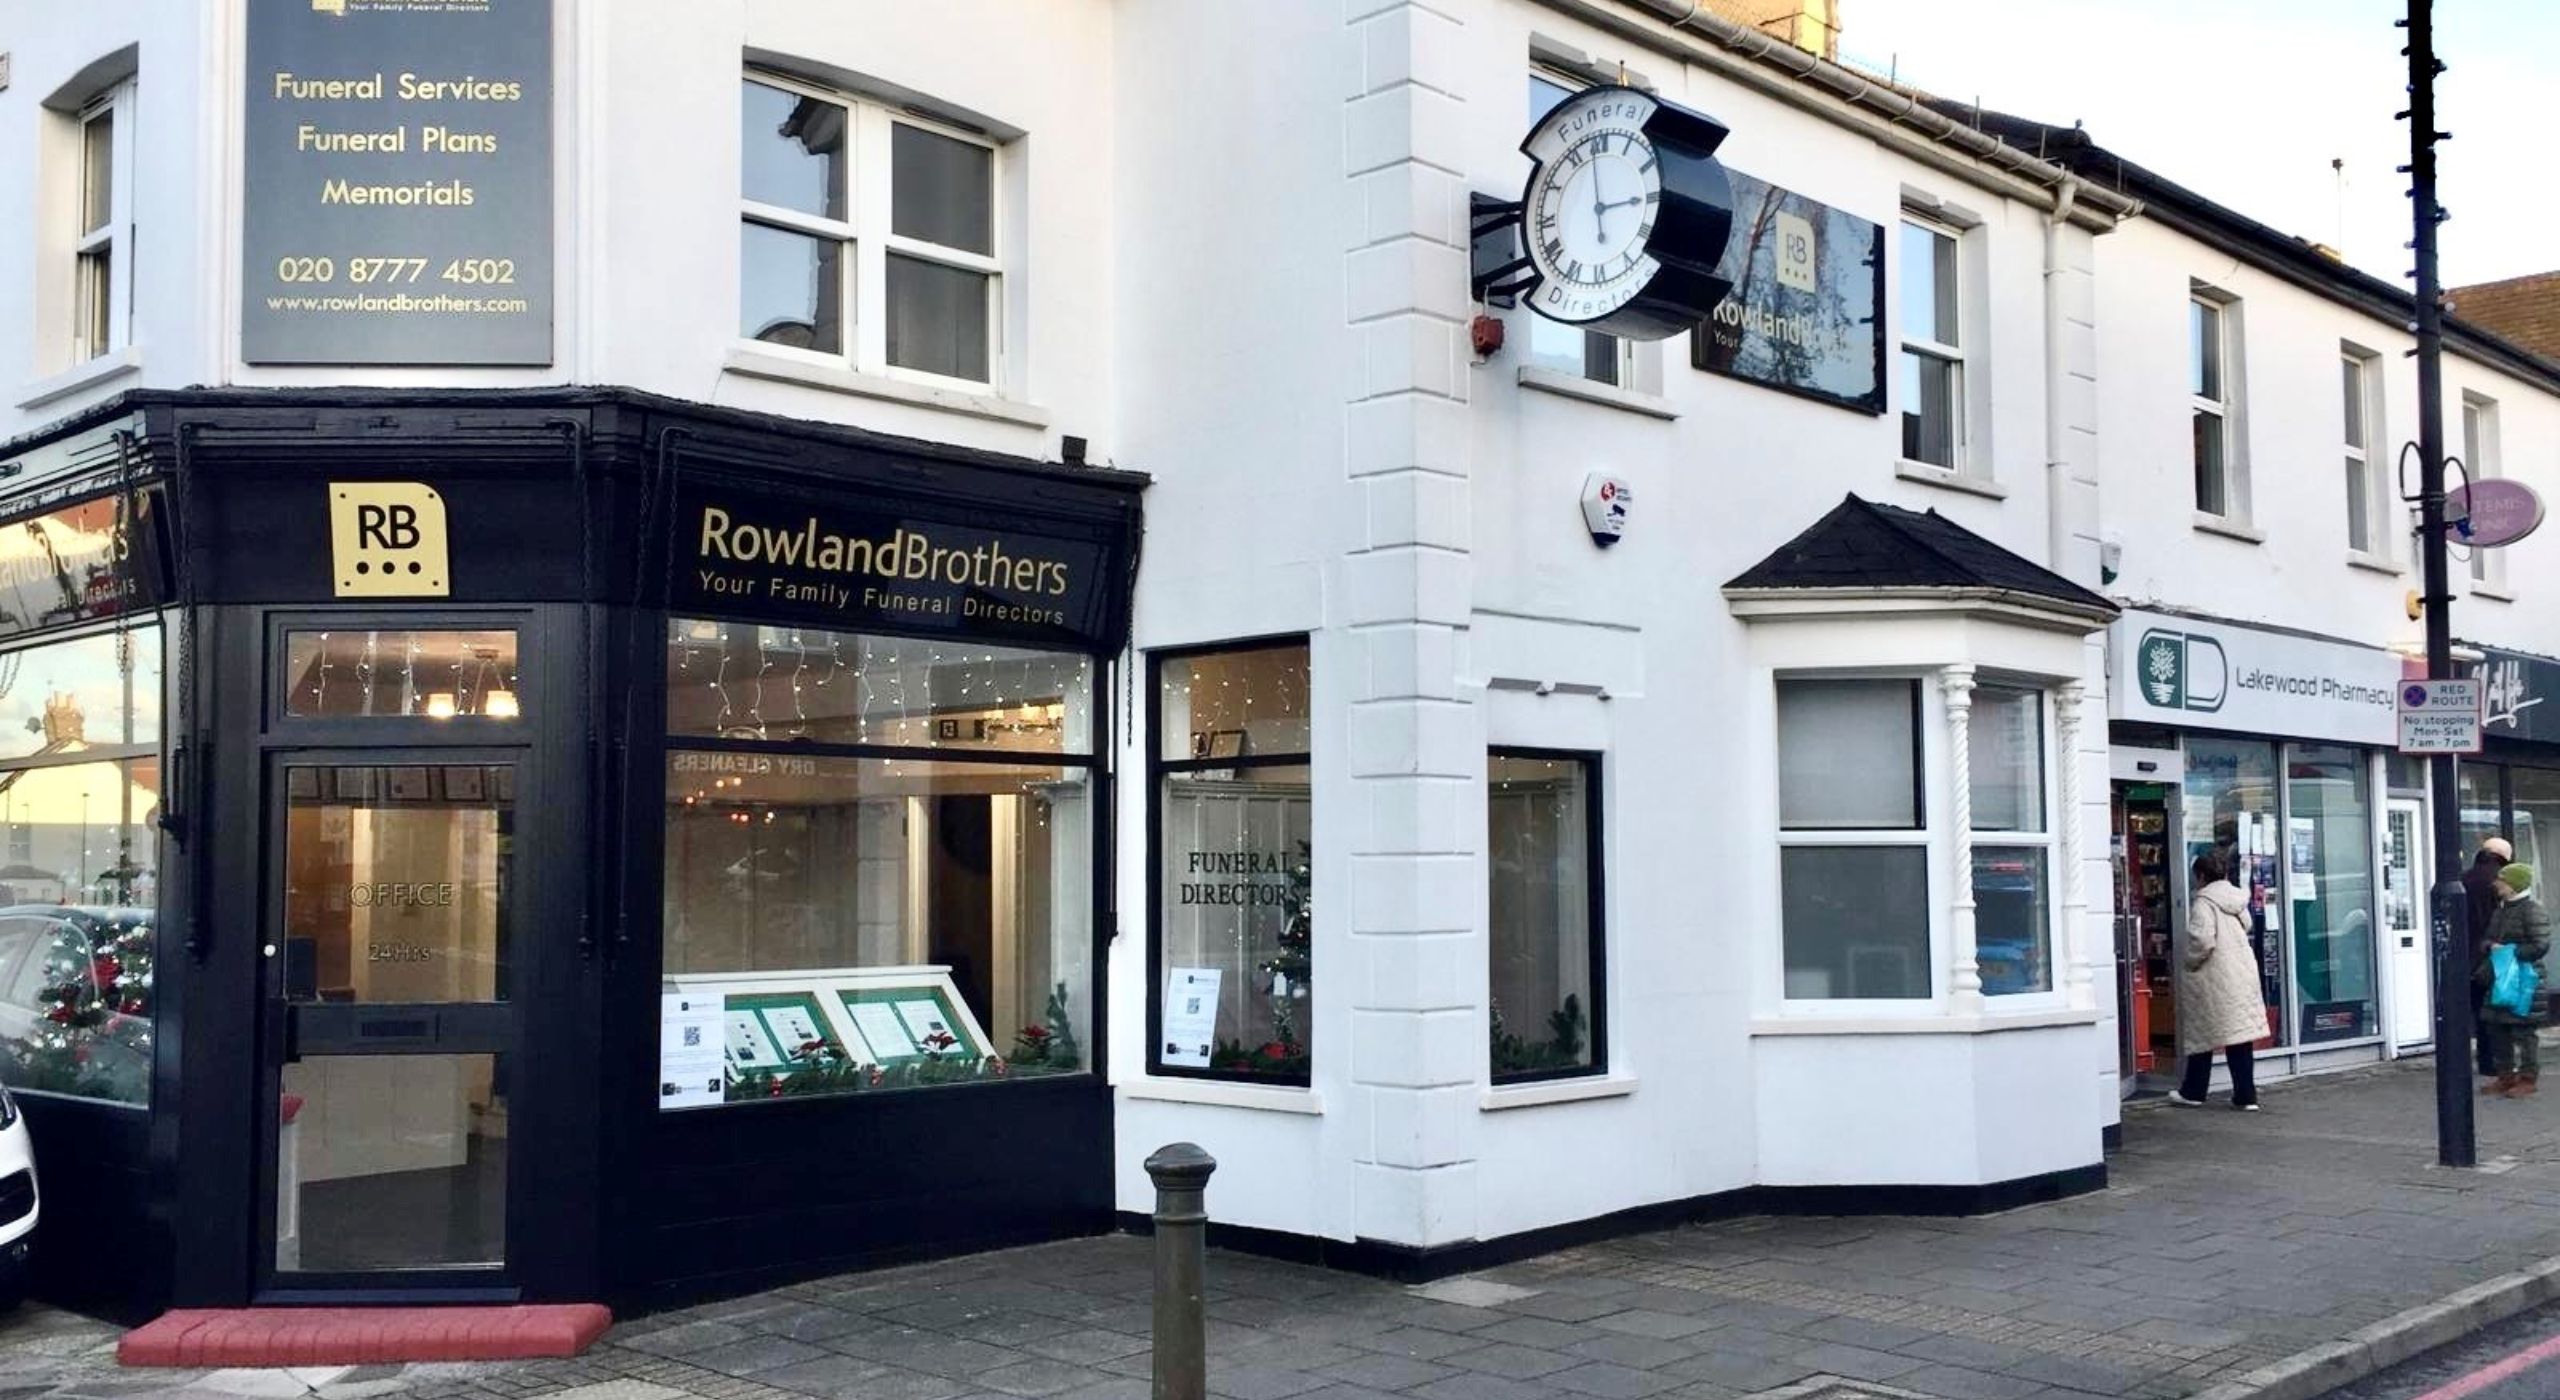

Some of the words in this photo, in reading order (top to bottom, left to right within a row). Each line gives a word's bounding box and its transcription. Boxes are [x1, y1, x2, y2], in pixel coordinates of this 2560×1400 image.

[275, 73, 382, 99] Funeral
[398, 73, 521, 101] Services
[1559, 102, 1645, 142] Funeral
[298, 126, 405, 152] Funeral
[422, 127, 497, 153] Plans
[321, 179, 474, 206] Memorials
[1786, 233, 1807, 265] RB
[279, 257, 333, 282] 020
[349, 258, 427, 283] 8777
[442, 259, 514, 284] 4502
[267, 293, 527, 313] www.rowlandbrothers.com
[1549, 268, 1653, 315] Directors
[1715, 329, 1738, 348] Your
[357, 505, 419, 549] RB
[700, 507, 1067, 595] RowlandBrothers
[700, 570, 756, 594] Your
[770, 578, 850, 608] Family
[864, 588, 951, 614] Funeral
[964, 597, 1064, 626] Directors
[2236, 666, 2318, 697] Lakewood
[2322, 678, 2394, 711] Pharmacy
[2431, 696, 2474, 706] ROUTE
[2440, 685, 2466, 695] RED
[2404, 716, 2420, 725] No
[2424, 716, 2474, 727] stopping
[2414, 727, 2464, 736] Mon-Sat
[1188, 852, 1291, 874] FUNERAL
[351, 882, 453, 906] OFFICE
[1181, 883, 1299, 907] DIRECTORS
[368, 944, 432, 962] 24Hrs
